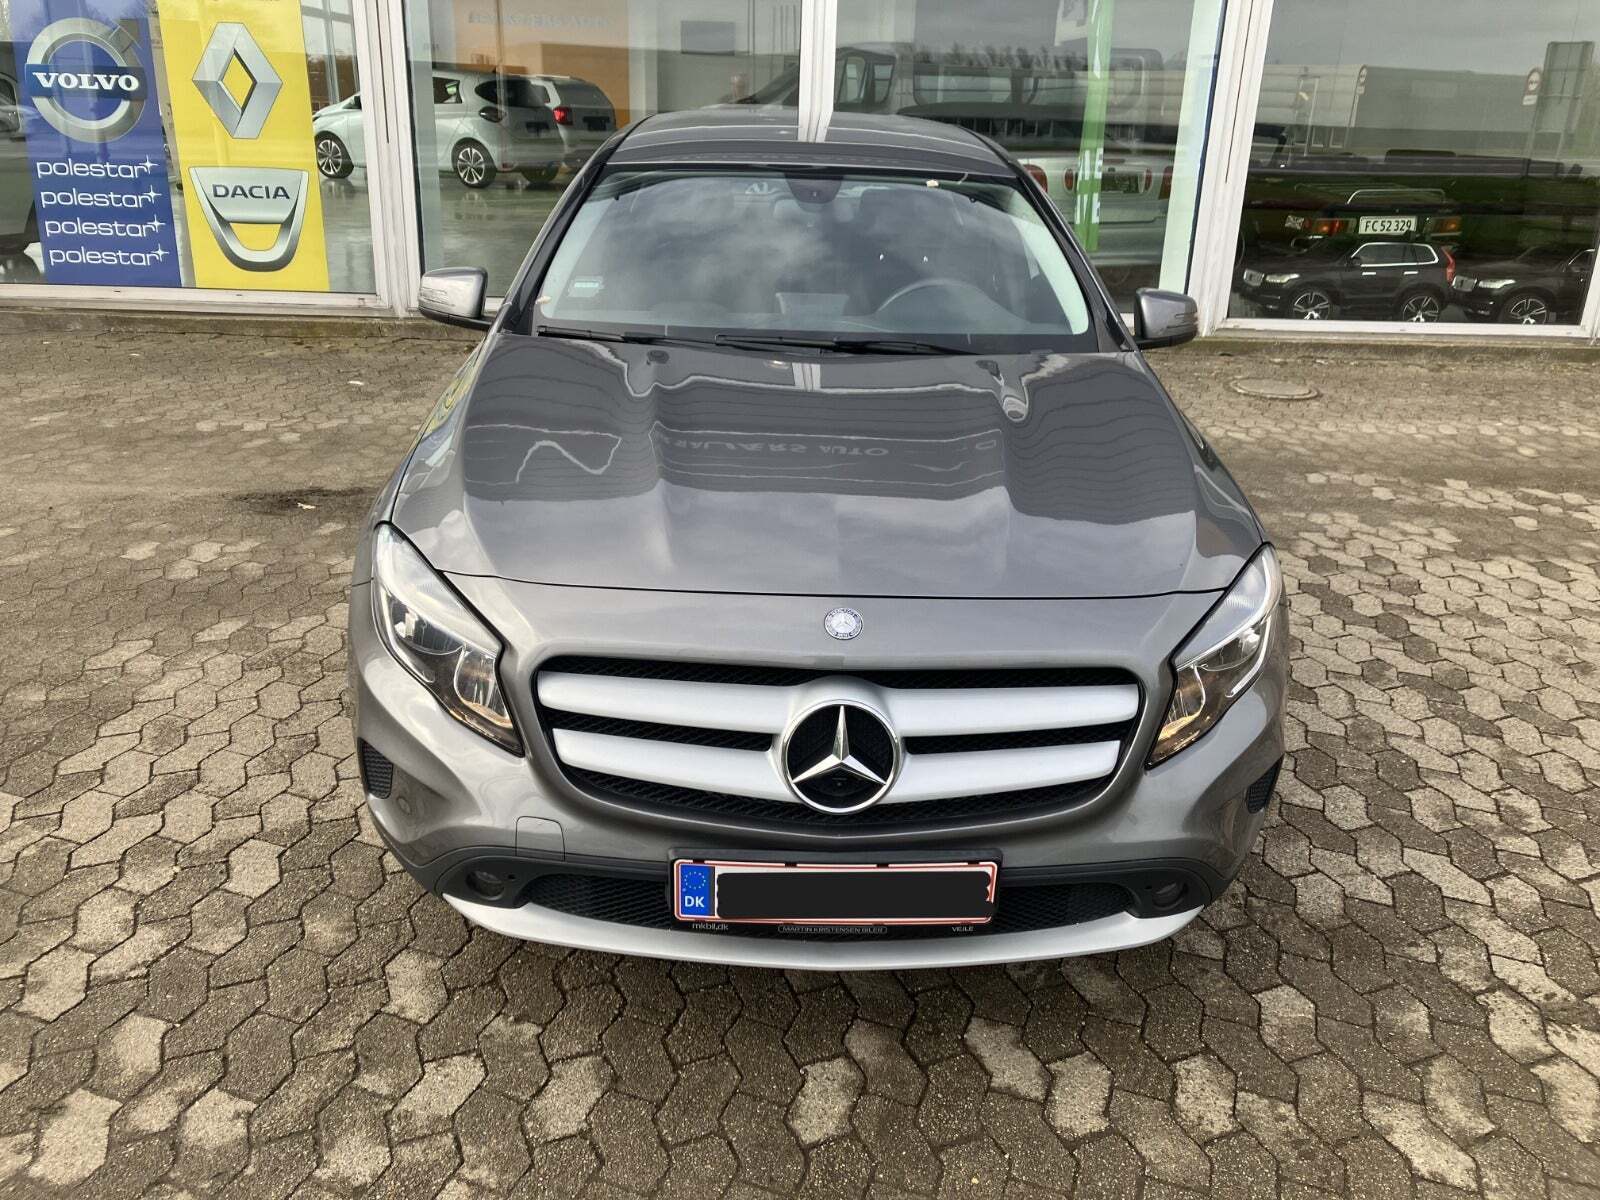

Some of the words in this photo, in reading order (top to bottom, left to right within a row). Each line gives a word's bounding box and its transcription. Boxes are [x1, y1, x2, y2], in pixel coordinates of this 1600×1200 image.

[32, 72, 140, 91] VOLVO
[36, 159, 149, 179] polestar
[41, 188, 153, 208] polestar
[211, 183, 291, 200] DACIA
[45, 217, 157, 238] polestar
[1364, 220, 1378, 233] FC
[1380, 220, 1392, 232] 52
[49, 246, 162, 267] polestar
[684, 895, 705, 908] DK
[691, 922, 729, 931] mkbil.dk
